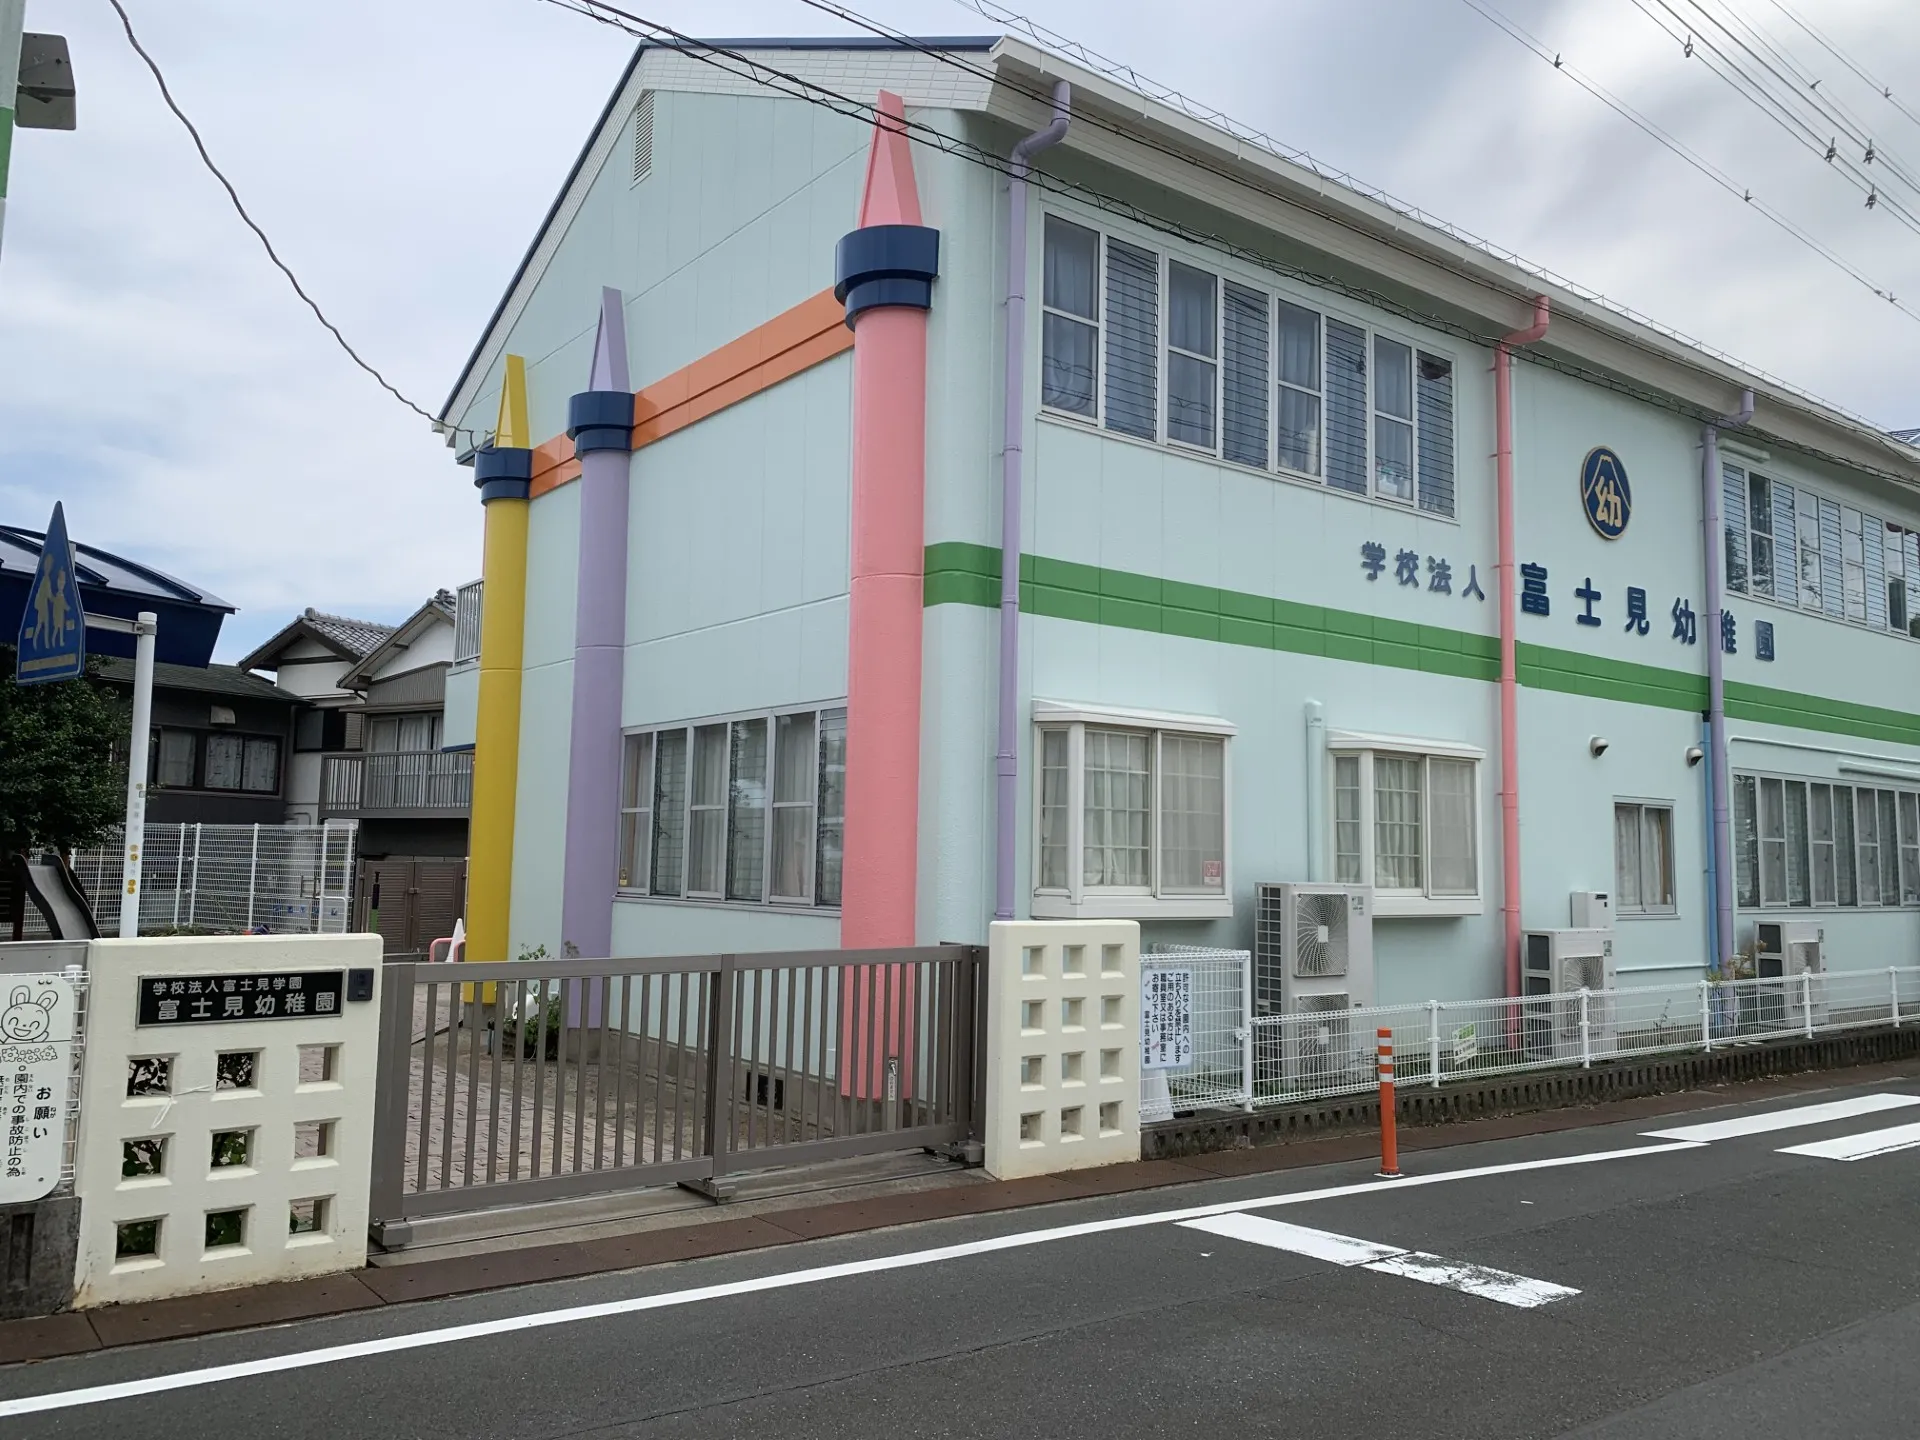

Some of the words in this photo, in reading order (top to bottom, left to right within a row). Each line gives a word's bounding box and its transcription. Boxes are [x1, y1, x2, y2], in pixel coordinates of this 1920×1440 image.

[1360, 540, 1486, 601] 学校法人
[152, 976, 303, 996] 学校法人富士見学園
[157, 991, 335, 1020] 富士見幼稚園
[1151, 973, 1159, 1033] お寄り下さい
[1167, 972, 1175, 1042] ご用のある方は
[6, 1073, 29, 1178] 園内での事故防止の為
[33, 1086, 52, 1139] お願い
